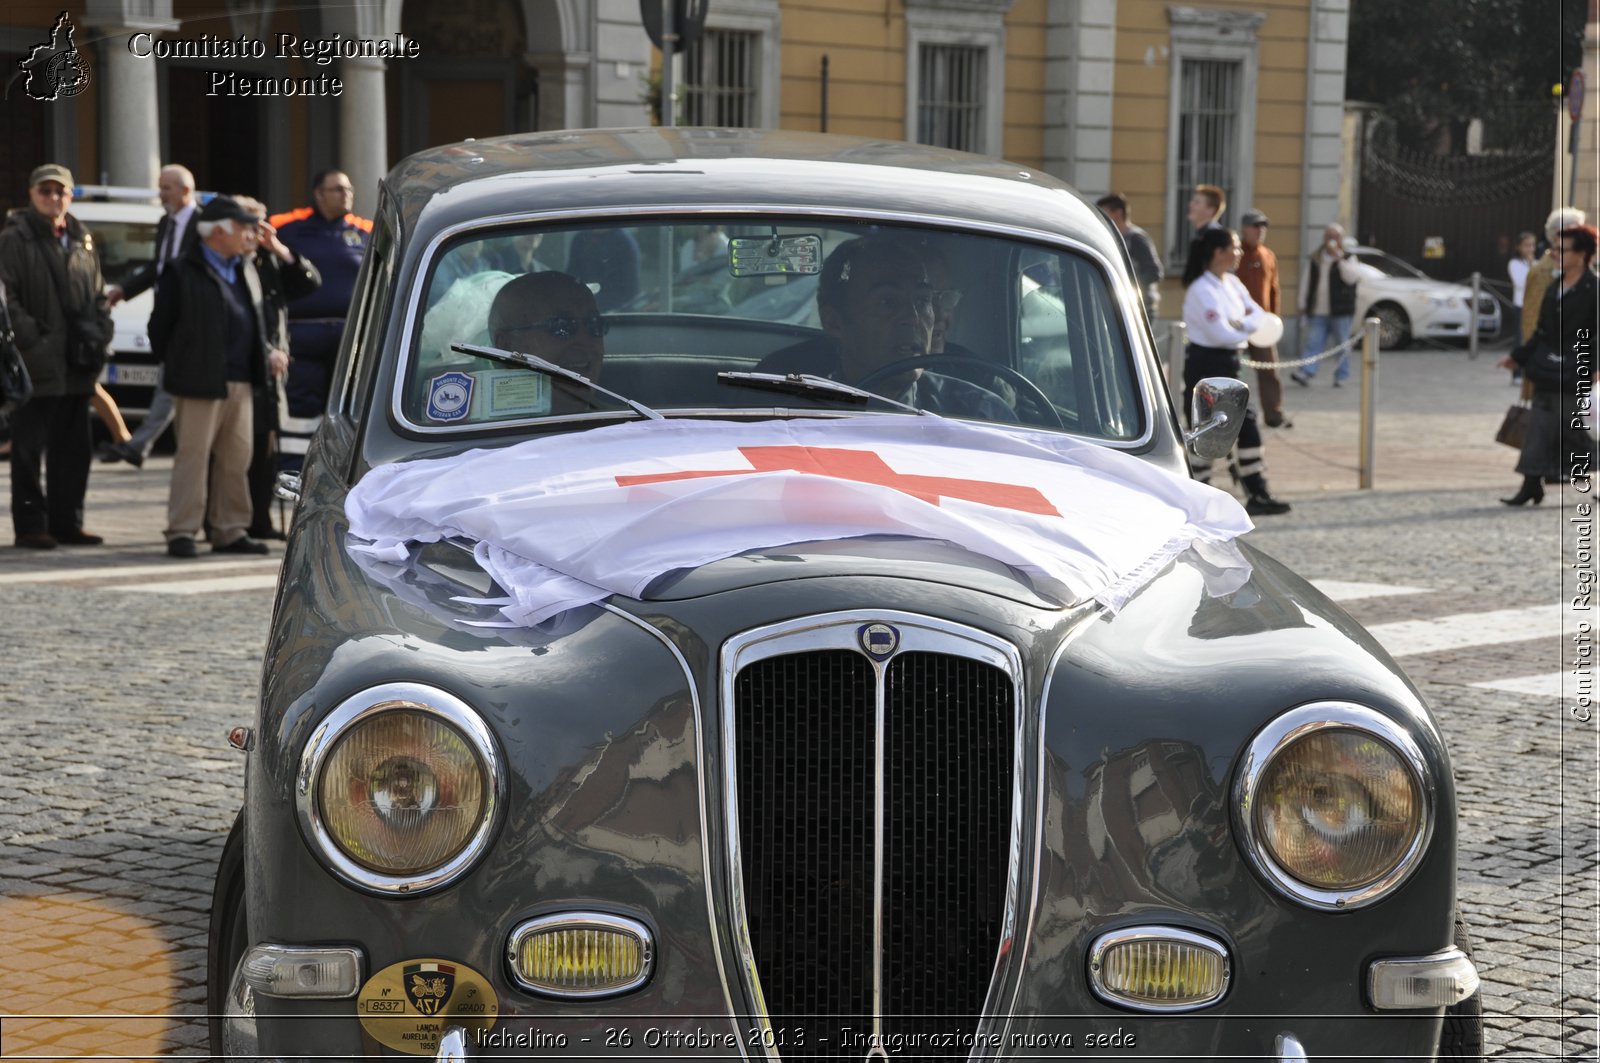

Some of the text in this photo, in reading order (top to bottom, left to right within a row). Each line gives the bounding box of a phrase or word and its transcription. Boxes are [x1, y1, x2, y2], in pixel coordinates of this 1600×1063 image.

[372, 1001, 399, 1011] 8537
[457, 1003, 486, 1013] GRADO
[416, 1023, 440, 1032] LANCIA
[402, 1033, 428, 1041] AURELIA
[420, 1042, 436, 1051] 1955
